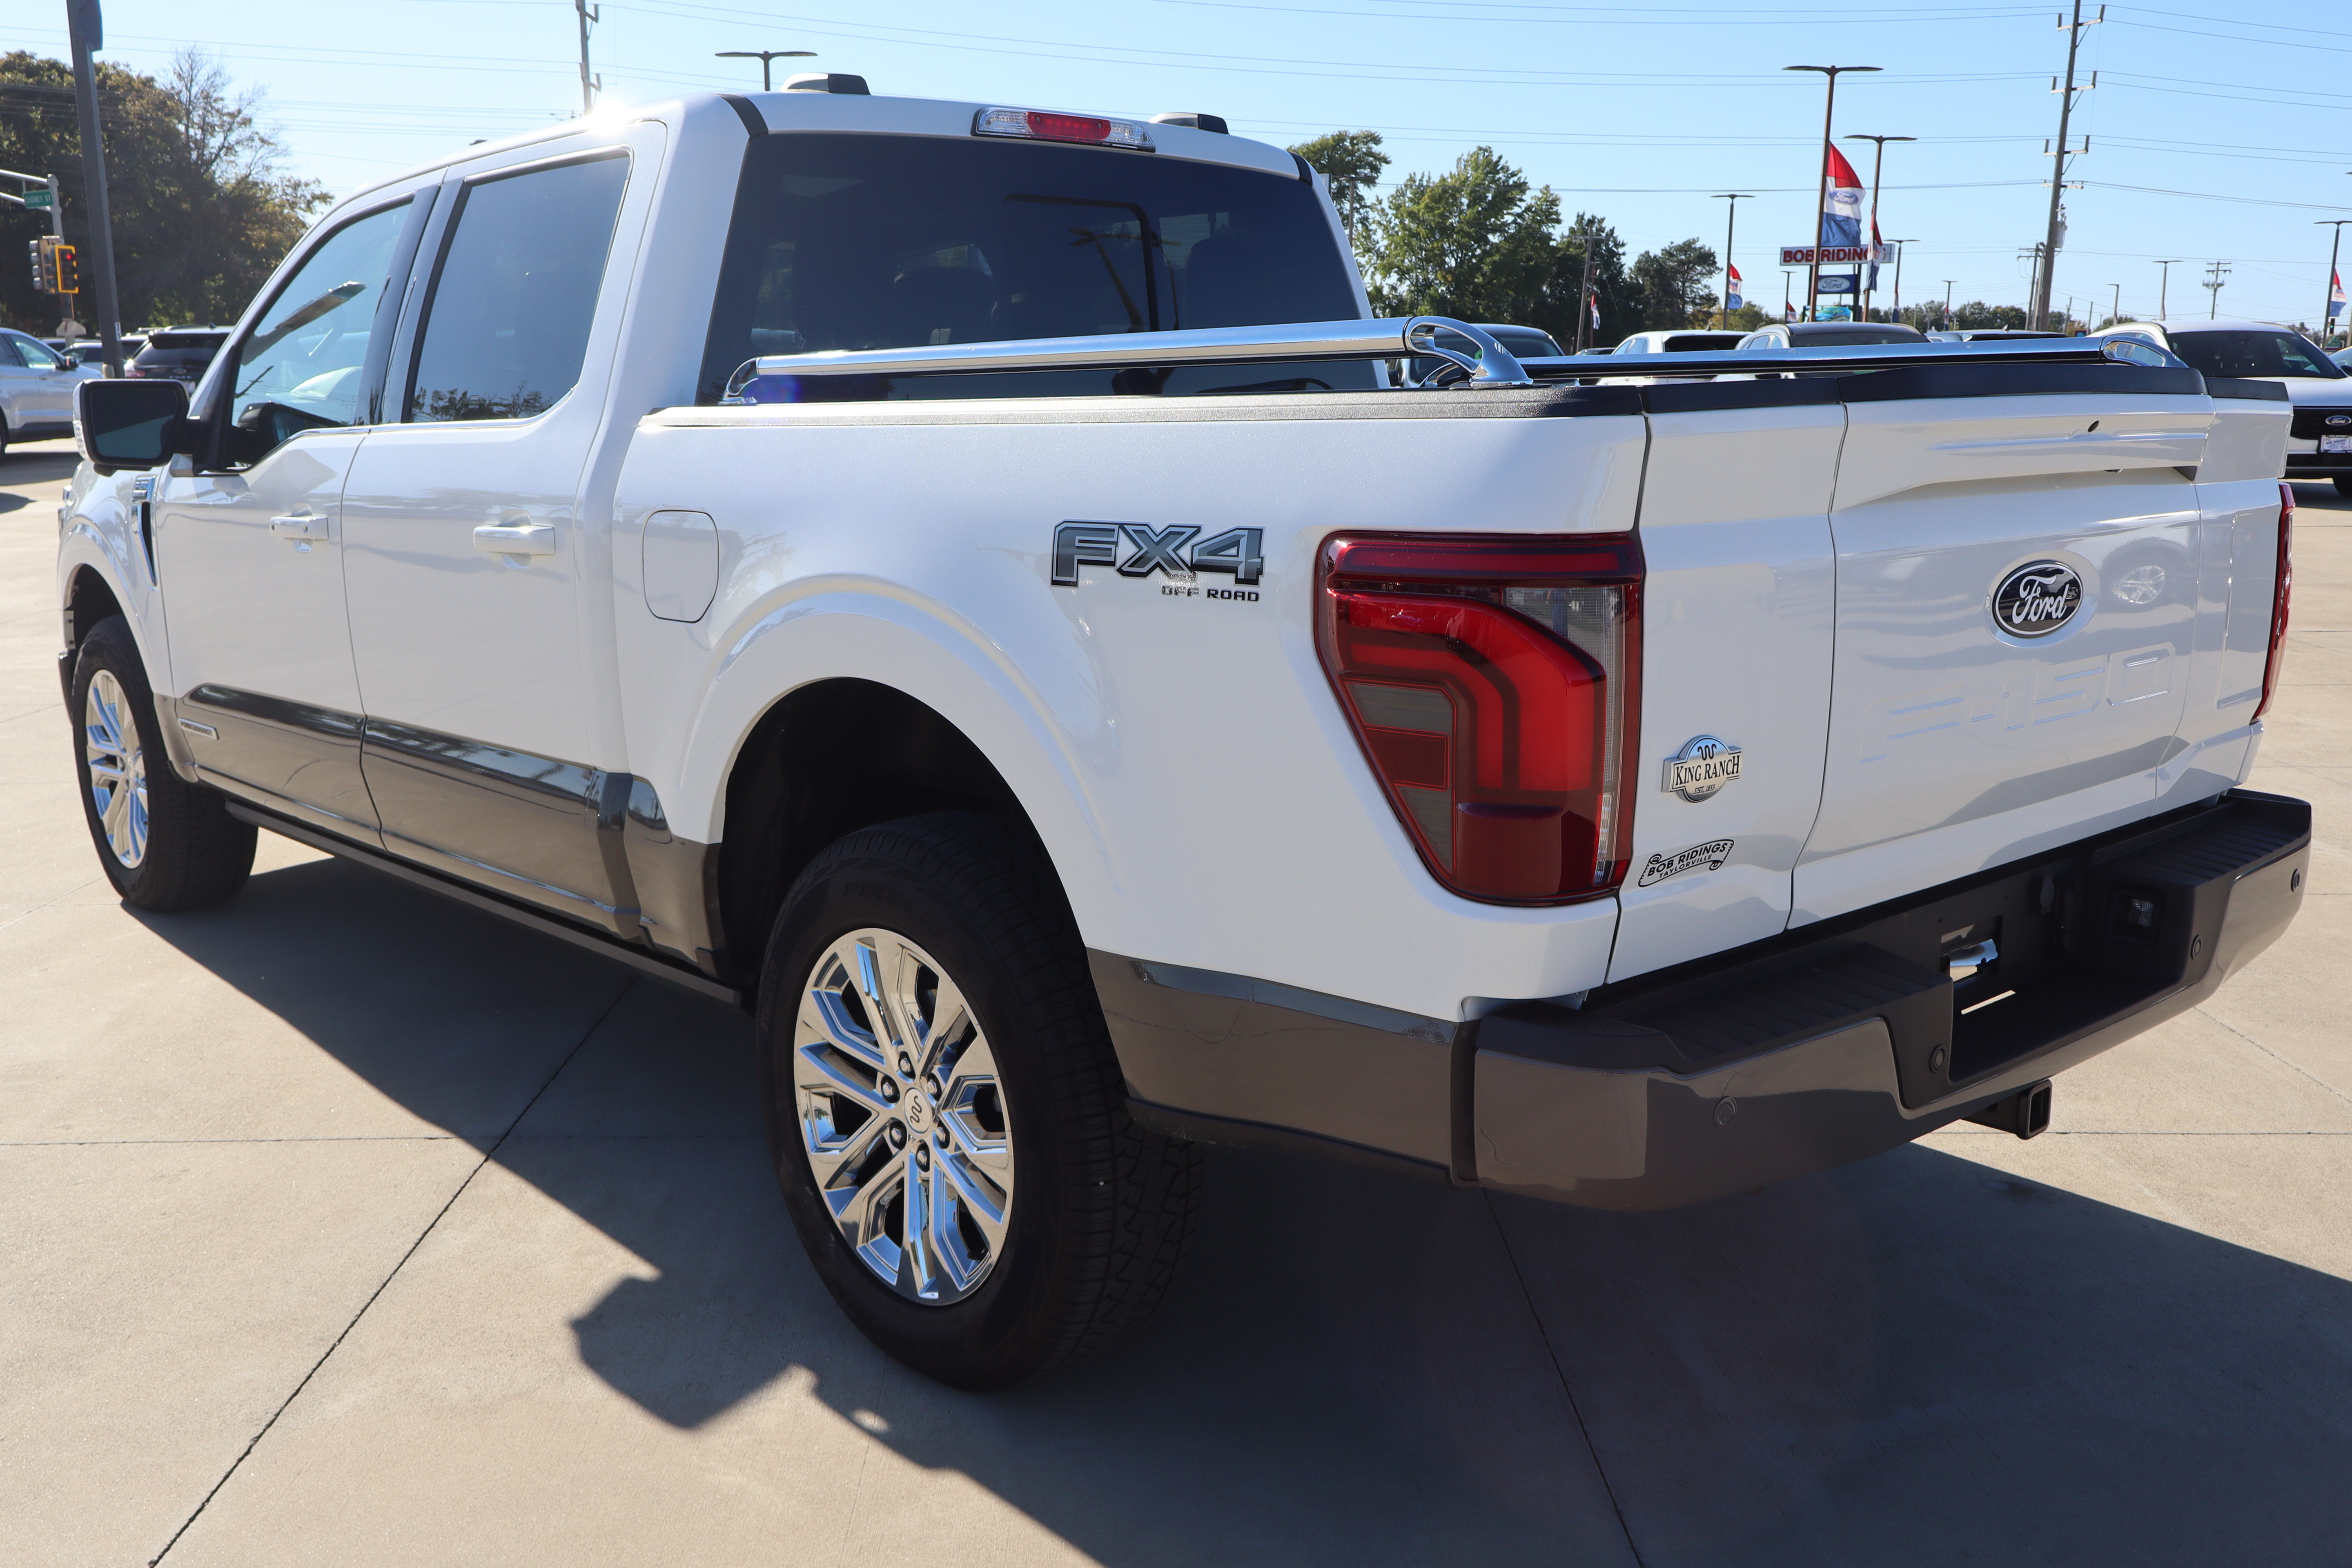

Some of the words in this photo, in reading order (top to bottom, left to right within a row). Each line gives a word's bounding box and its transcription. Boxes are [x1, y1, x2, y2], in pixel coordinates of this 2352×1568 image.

[1834, 192, 1855, 203] Ford
[1783, 249, 1815, 263] BOB
[1821, 247, 1886, 262] RIDIN
[1822, 279, 1843, 289] Ford
[1051, 518, 1265, 588] FX4
[1161, 586, 1200, 597] OFF
[1207, 589, 1259, 602] ROAD
[2011, 575, 2069, 624] Ford
[1860, 641, 2176, 763] F-150
[1675, 765, 1702, 786] KING
[1704, 755, 1740, 780] RANCH
[1647, 859, 1674, 877] BOB
[1678, 842, 1728, 865] RIDINGS
[1659, 854, 1713, 878] TAYLORVILLE
